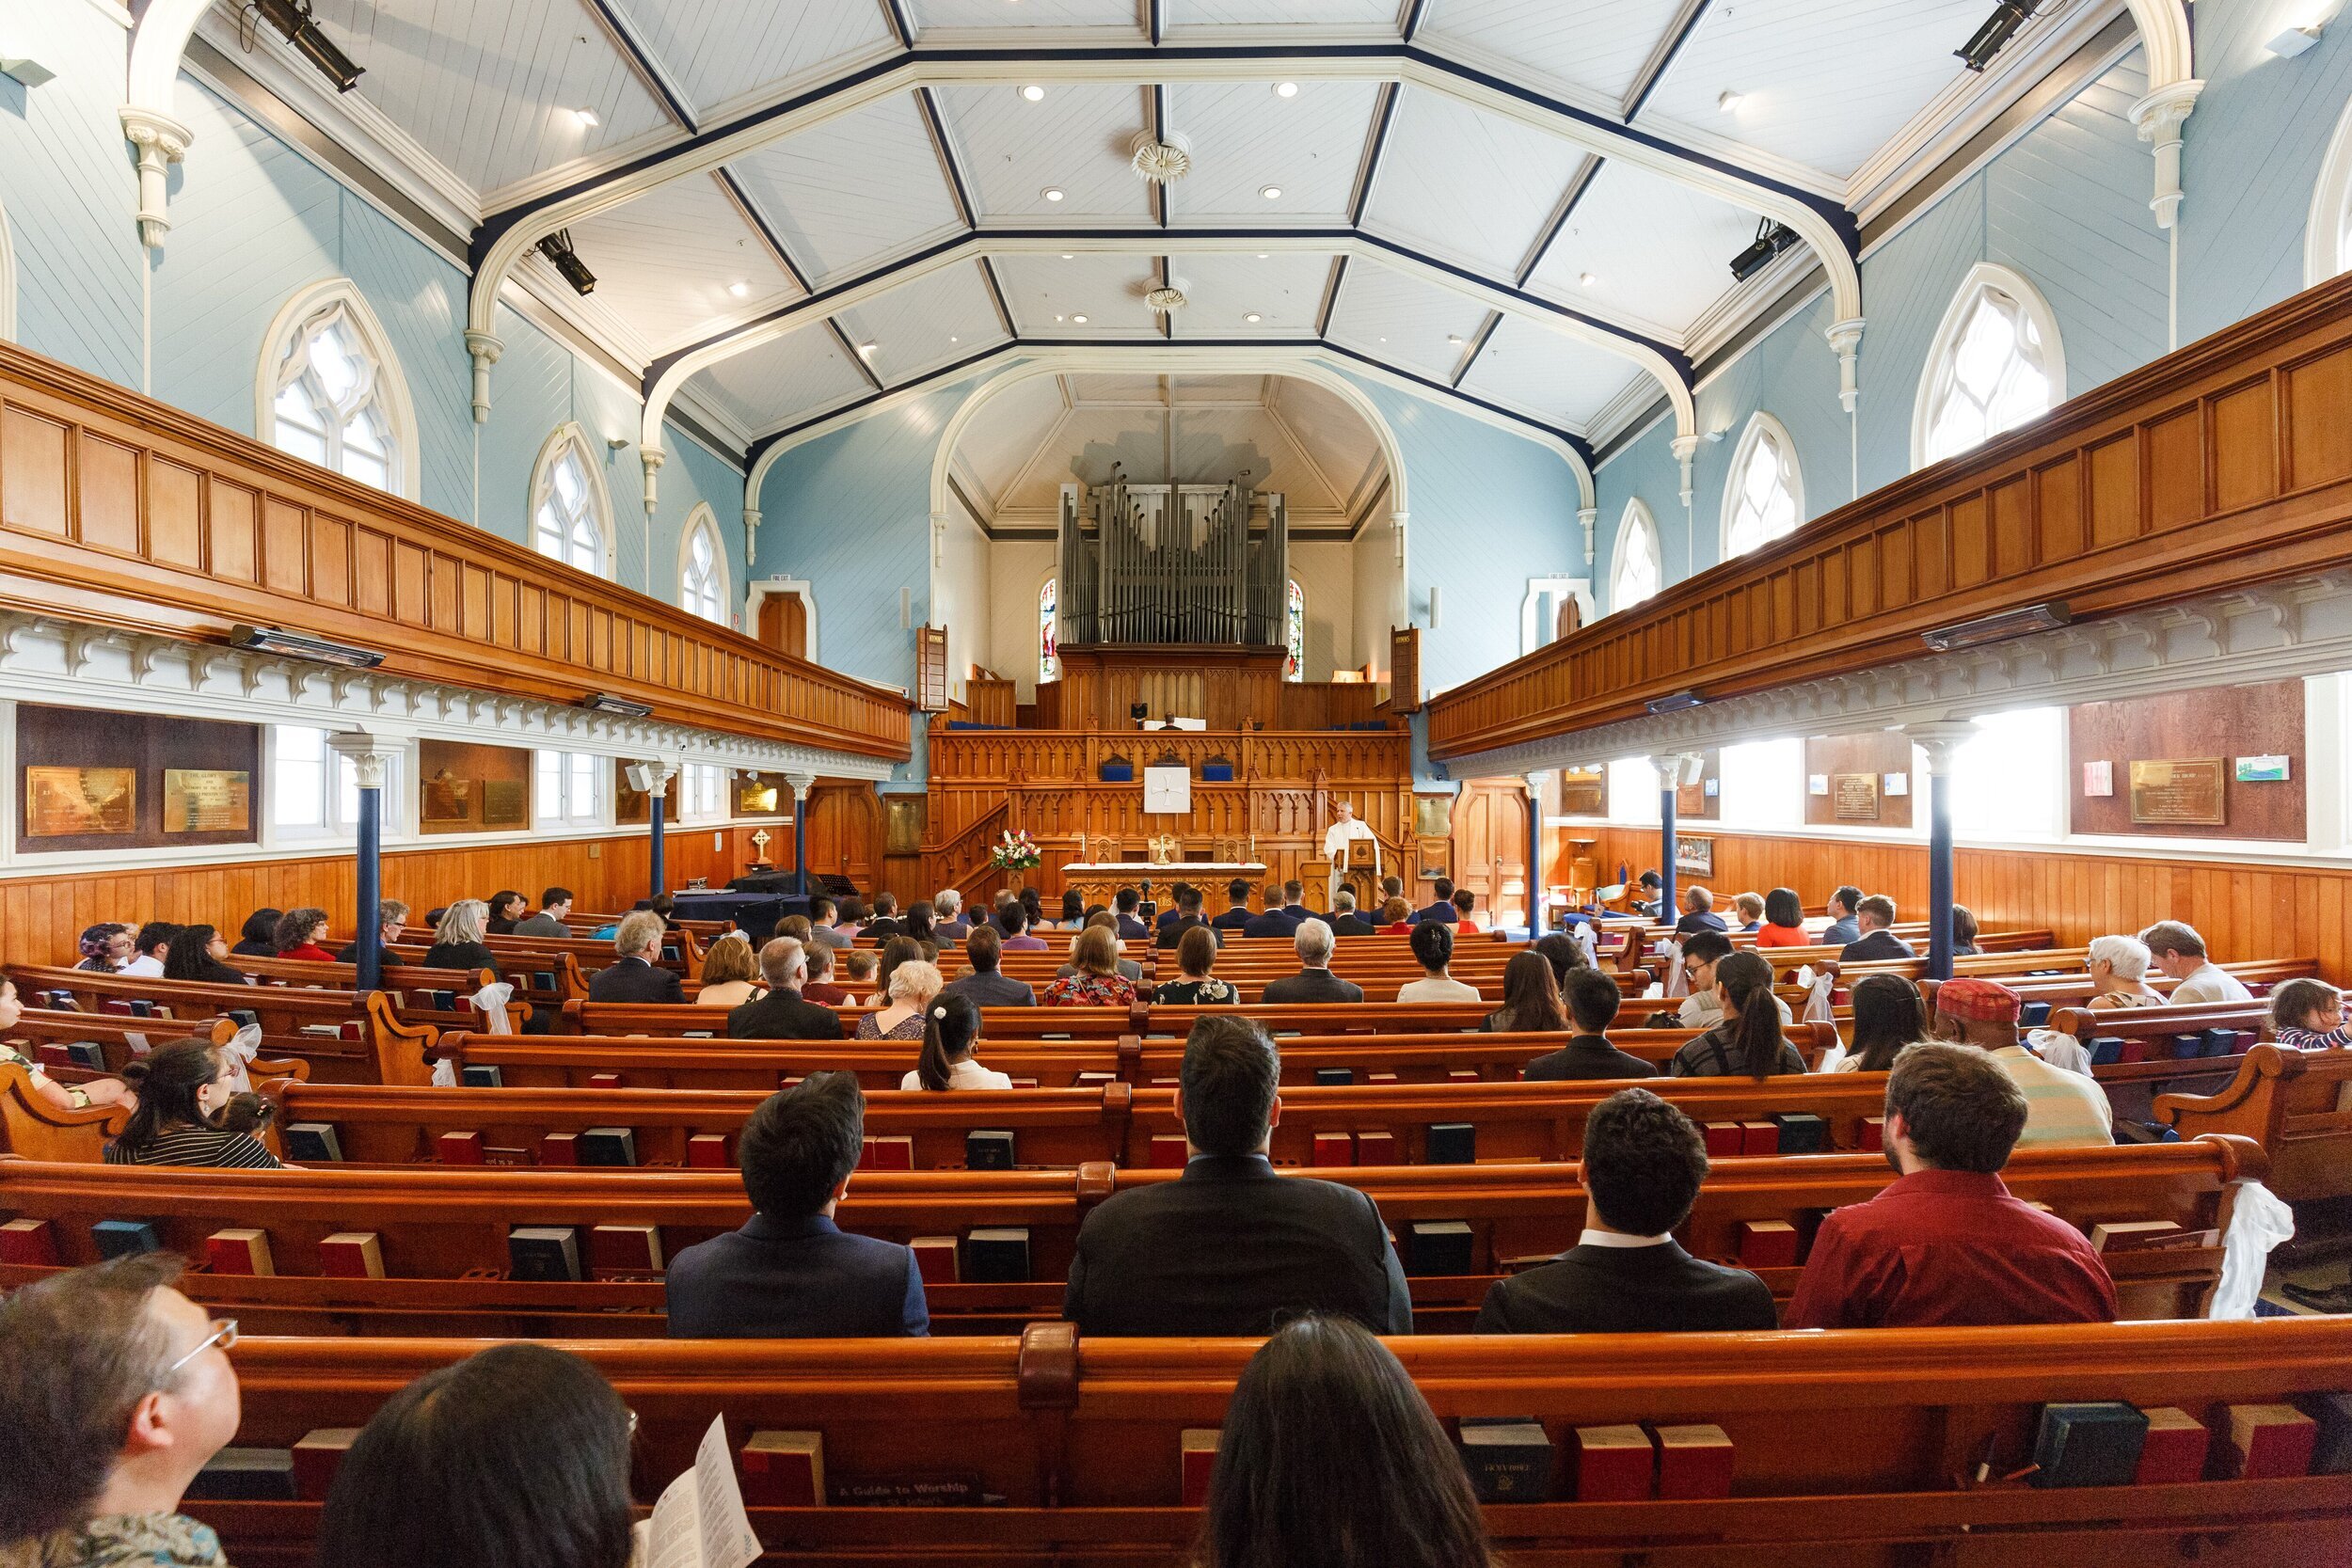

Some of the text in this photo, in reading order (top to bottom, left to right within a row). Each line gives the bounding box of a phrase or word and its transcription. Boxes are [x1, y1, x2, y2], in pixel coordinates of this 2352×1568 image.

[930, 635, 943, 643] HYMNS
[840, 1482, 969, 1497] A Guide to Worship
